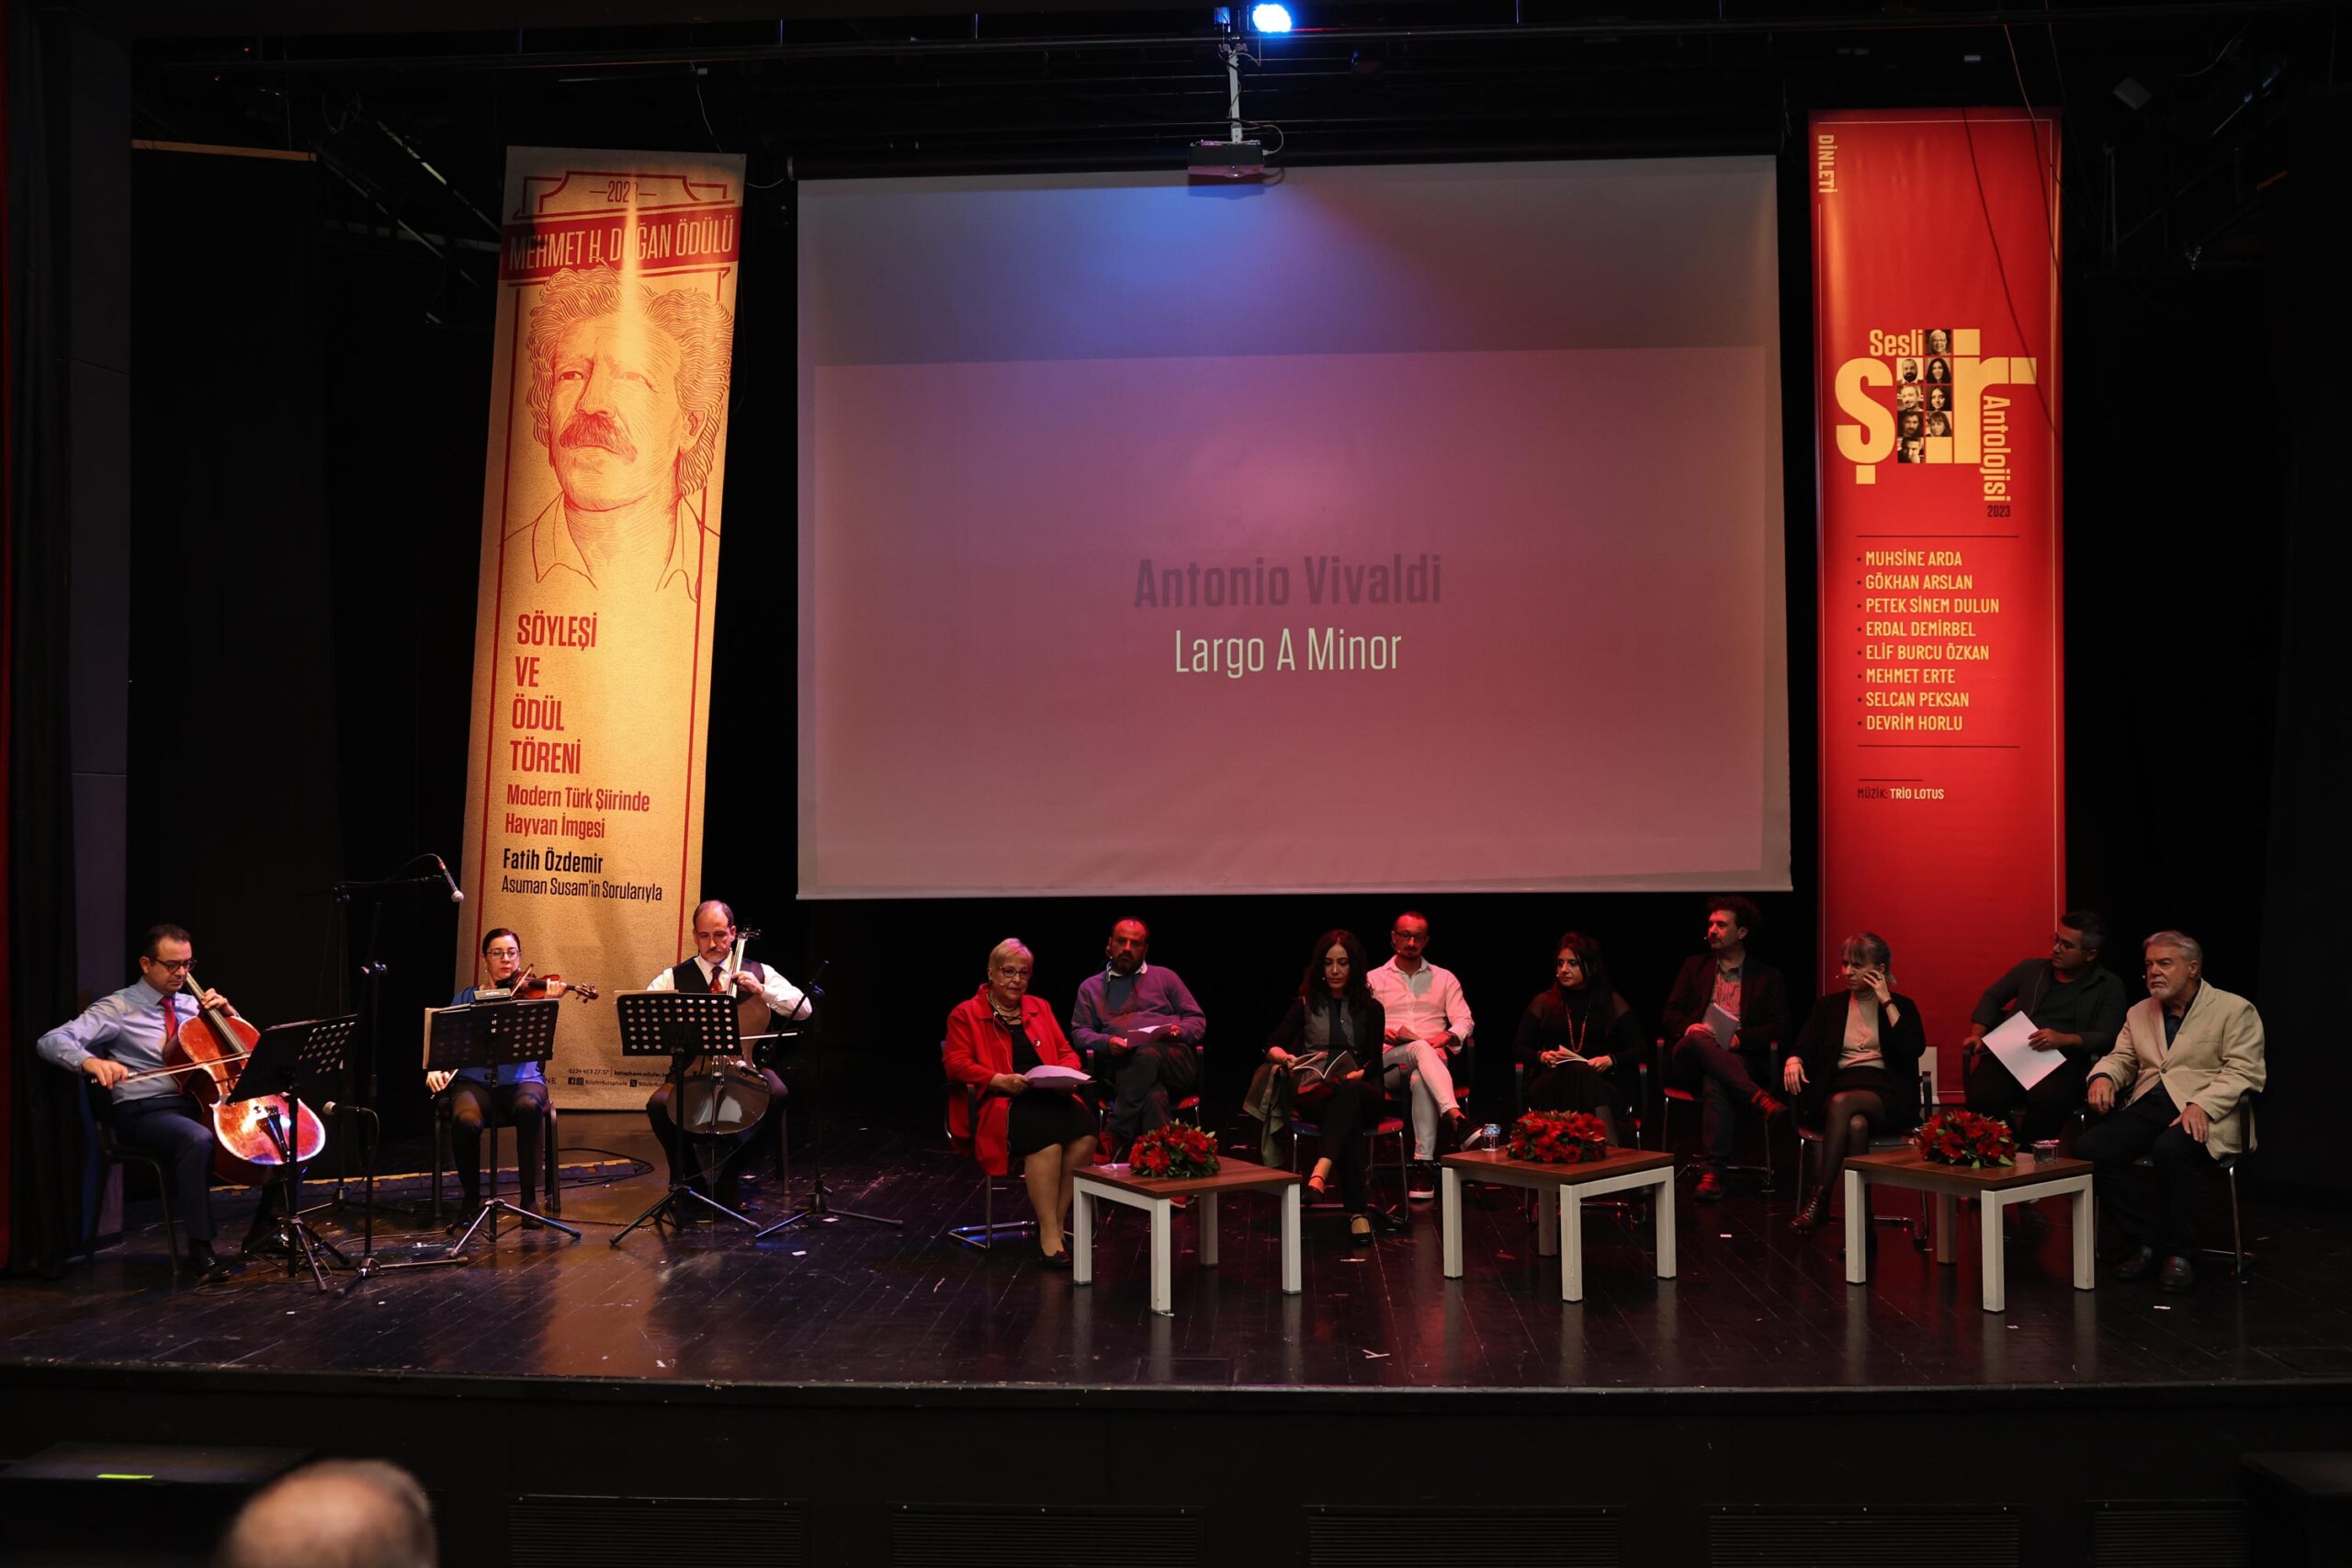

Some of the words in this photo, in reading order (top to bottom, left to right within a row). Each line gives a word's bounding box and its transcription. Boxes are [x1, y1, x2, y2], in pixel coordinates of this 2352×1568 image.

[1818, 134, 1838, 193] DİNLETİ
[509, 231, 585, 271] MEHMET
[675, 215, 734, 257] ÖDÜLÜ
[1870, 329, 1924, 356] Sesli
[1980, 395, 2011, 502] Antolojisi
[1987, 505, 2011, 518] 2023
[1866, 548, 1925, 566] MUHSİNE
[1928, 551, 1962, 566] ARDA
[1134, 558, 1290, 608] Antonio
[1303, 554, 1442, 604] Vivaldi
[1865, 571, 1919, 590] GÖKHAN
[1923, 575, 1973, 590] ARSLAN
[1866, 598, 1906, 614] PETEK
[1909, 595, 1950, 614] SİNEM
[1954, 598, 1999, 614] DULUN
[516, 610, 597, 650] SÖYLEŞİ
[1866, 621, 1907, 637] ERDAL
[1911, 618, 1976, 637] DEMİRBEL
[1176, 630, 1264, 679] Largo
[1276, 628, 1295, 671] A
[1308, 627, 1402, 671] Minor
[1866, 642, 1894, 660] ELİF
[1897, 645, 1942, 660] BURCU
[1946, 642, 1989, 660] ÖZKAN
[515, 656, 540, 687] VE
[1866, 669, 1919, 683] MEHMET
[1923, 669, 1955, 683] ERTE
[511, 694, 564, 731] ÖDÜL
[1865, 692, 1915, 706] SELCAN
[1919, 692, 1969, 707] PEKSAN
[1866, 713, 1915, 730] DEVRİM
[1918, 716, 1962, 730] HORLU
[510, 736, 581, 773] TÖRENİ
[507, 784, 561, 807] Modern
[565, 786, 593, 809] Türk
[595, 788, 650, 812] Şiirinde
[1890, 786, 1911, 799] TRİO
[1914, 788, 1944, 800] LOTUS
[505, 813, 558, 837] Hayvan
[561, 812, 605, 840] İmgesi
[503, 848, 539, 871] Fatih
[544, 847, 604, 874] Özdemir
[502, 875, 547, 895] Asuman
[602, 882, 662, 903] Sorularıyla
